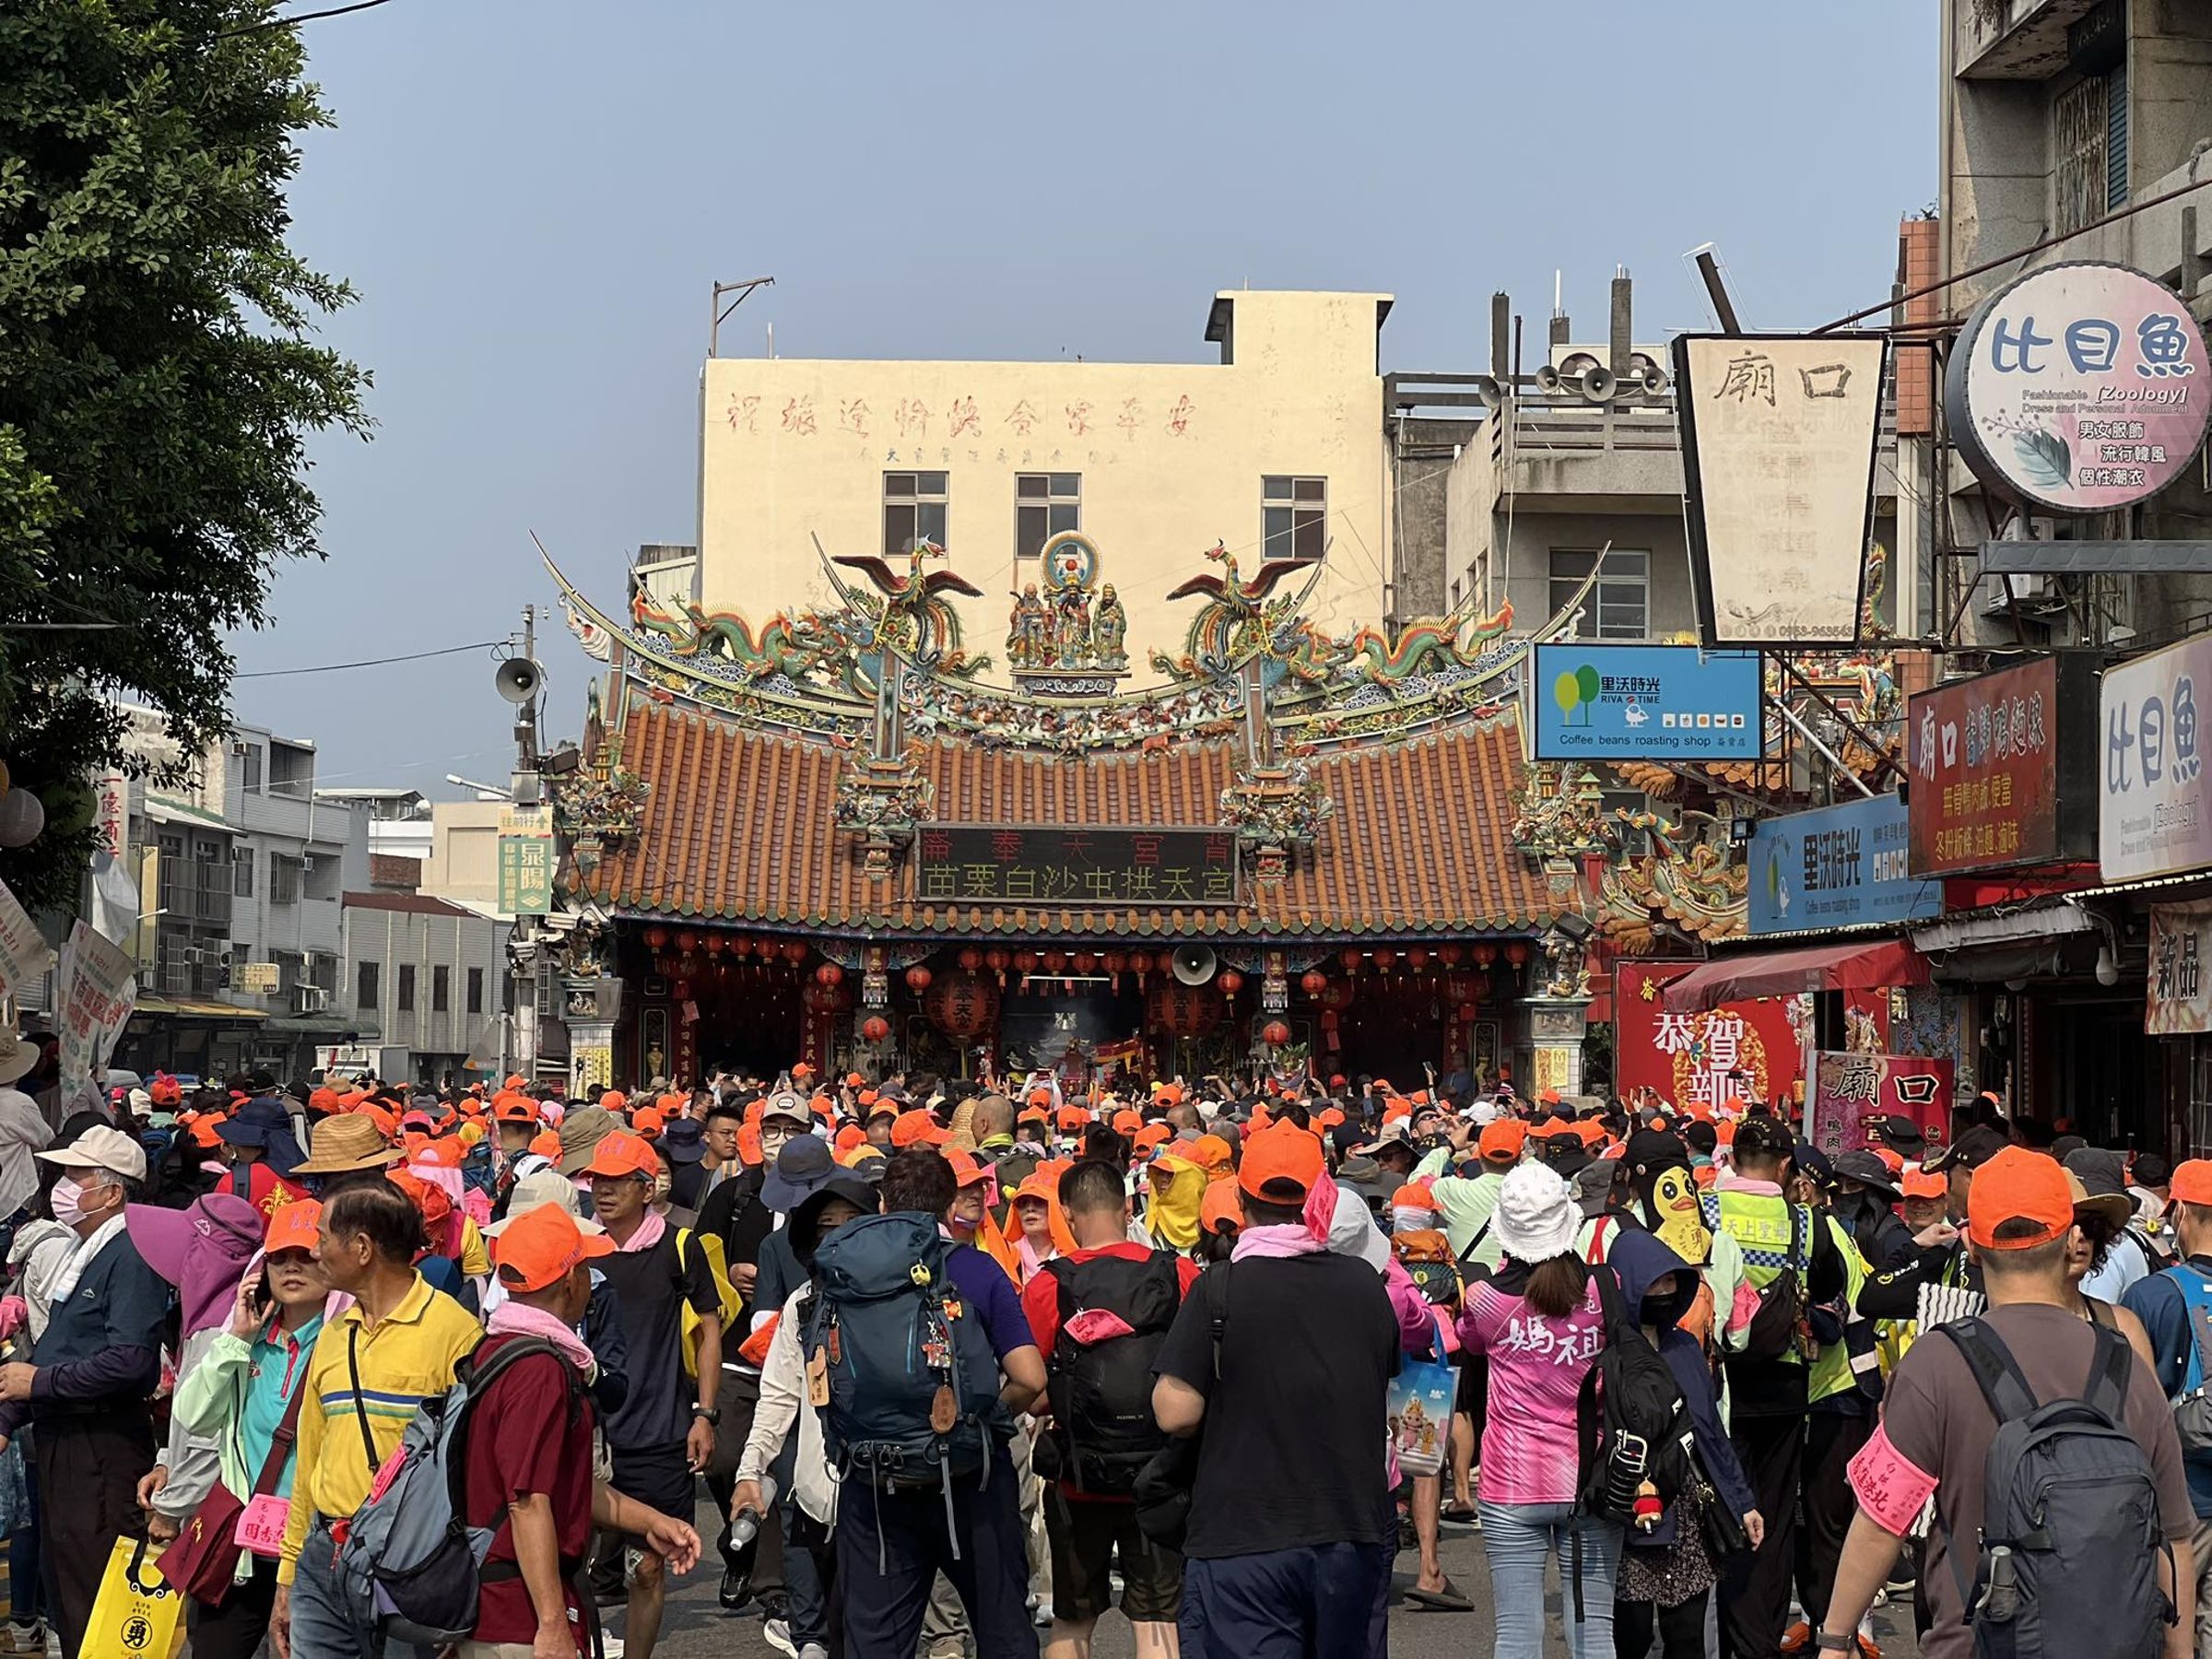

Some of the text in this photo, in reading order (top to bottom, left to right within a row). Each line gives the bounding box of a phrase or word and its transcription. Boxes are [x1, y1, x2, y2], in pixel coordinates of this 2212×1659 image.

[1991, 312, 2194, 377] 比目魚
[1714, 347, 1853, 407] 廟口
[2022, 389, 2088, 401] Fashionable
[2022, 403, 2053, 414] Dress
[2055, 403, 2076, 414] and
[2077, 403, 2125, 414] Personal
[2079, 421, 2145, 440] 男女服飾
[2101, 446, 2166, 464] 流行韓風
[2079, 468, 2145, 487] 個性潮衣
[1601, 677, 1660, 691] 里沃時光
[1559, 735, 1594, 745] Coffee
[1599, 735, 1630, 745] beans
[1635, 735, 1678, 747] roasting
[1684, 735, 1711, 747] shop
[1918, 705, 1958, 782] 廟口
[2108, 677, 2200, 794] 比目魚
[1804, 827, 1861, 891] 里沃時光
[924, 864, 1233, 900] 苗栗白沙屯拱天宮
[2157, 931, 2200, 1000] 新品
[1653, 1010, 1744, 1070] 恭賀
[1830, 1061, 1939, 1107] 廟口
[1497, 1314, 1603, 1366] 媽祖
[127, 1619, 147, 1647] 勇
